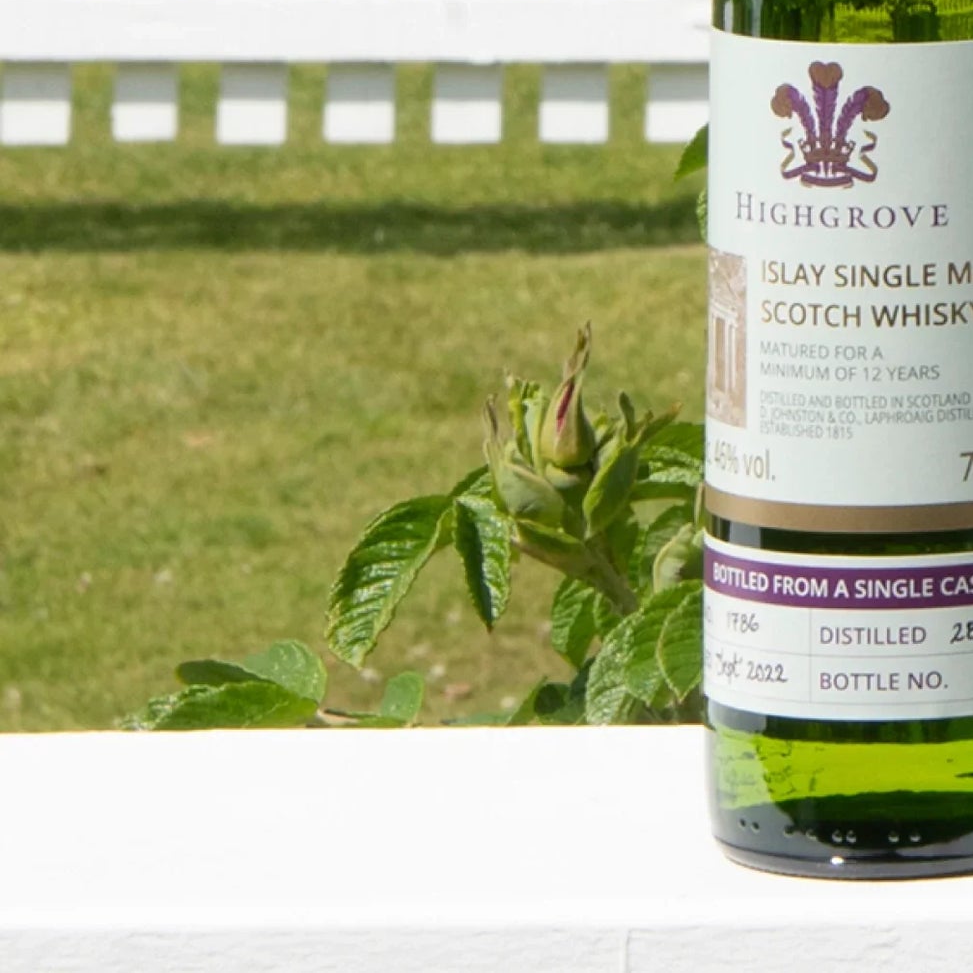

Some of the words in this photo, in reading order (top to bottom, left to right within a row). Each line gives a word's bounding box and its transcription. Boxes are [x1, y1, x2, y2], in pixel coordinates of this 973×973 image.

[734, 191, 950, 229] HIGHGROVE
[761, 260, 826, 287] ISLAY
[834, 262, 937, 288] SINGLE
[761, 299, 861, 328] SCOTCH
[760, 340, 830, 360] MATURED
[834, 345, 868, 361] FOR
[871, 346, 884, 361] A
[760, 361, 830, 381] MINIMUM
[835, 366, 857, 382] OF
[863, 366, 881, 382] 12
[886, 364, 940, 382] YEARS
[808, 395, 833, 408] AND
[834, 395, 888, 409] BOTTLED
[891, 396, 904, 408] IN
[907, 392, 971, 409] SCOTLAND
[864, 411, 934, 425] LAPHROAIG
[827, 425, 854, 441] 1815
[742, 448, 777, 482] vol.
[713, 562, 770, 593] BOTTLED
[773, 574, 829, 599] FROM
[832, 578, 850, 599] A
[855, 578, 934, 600] SINGLE
[819, 625, 928, 646] DISTILLED
[746, 659, 788, 684] 2022
[819, 671, 899, 692] BOTTLE
[907, 670, 949, 691] NO.
